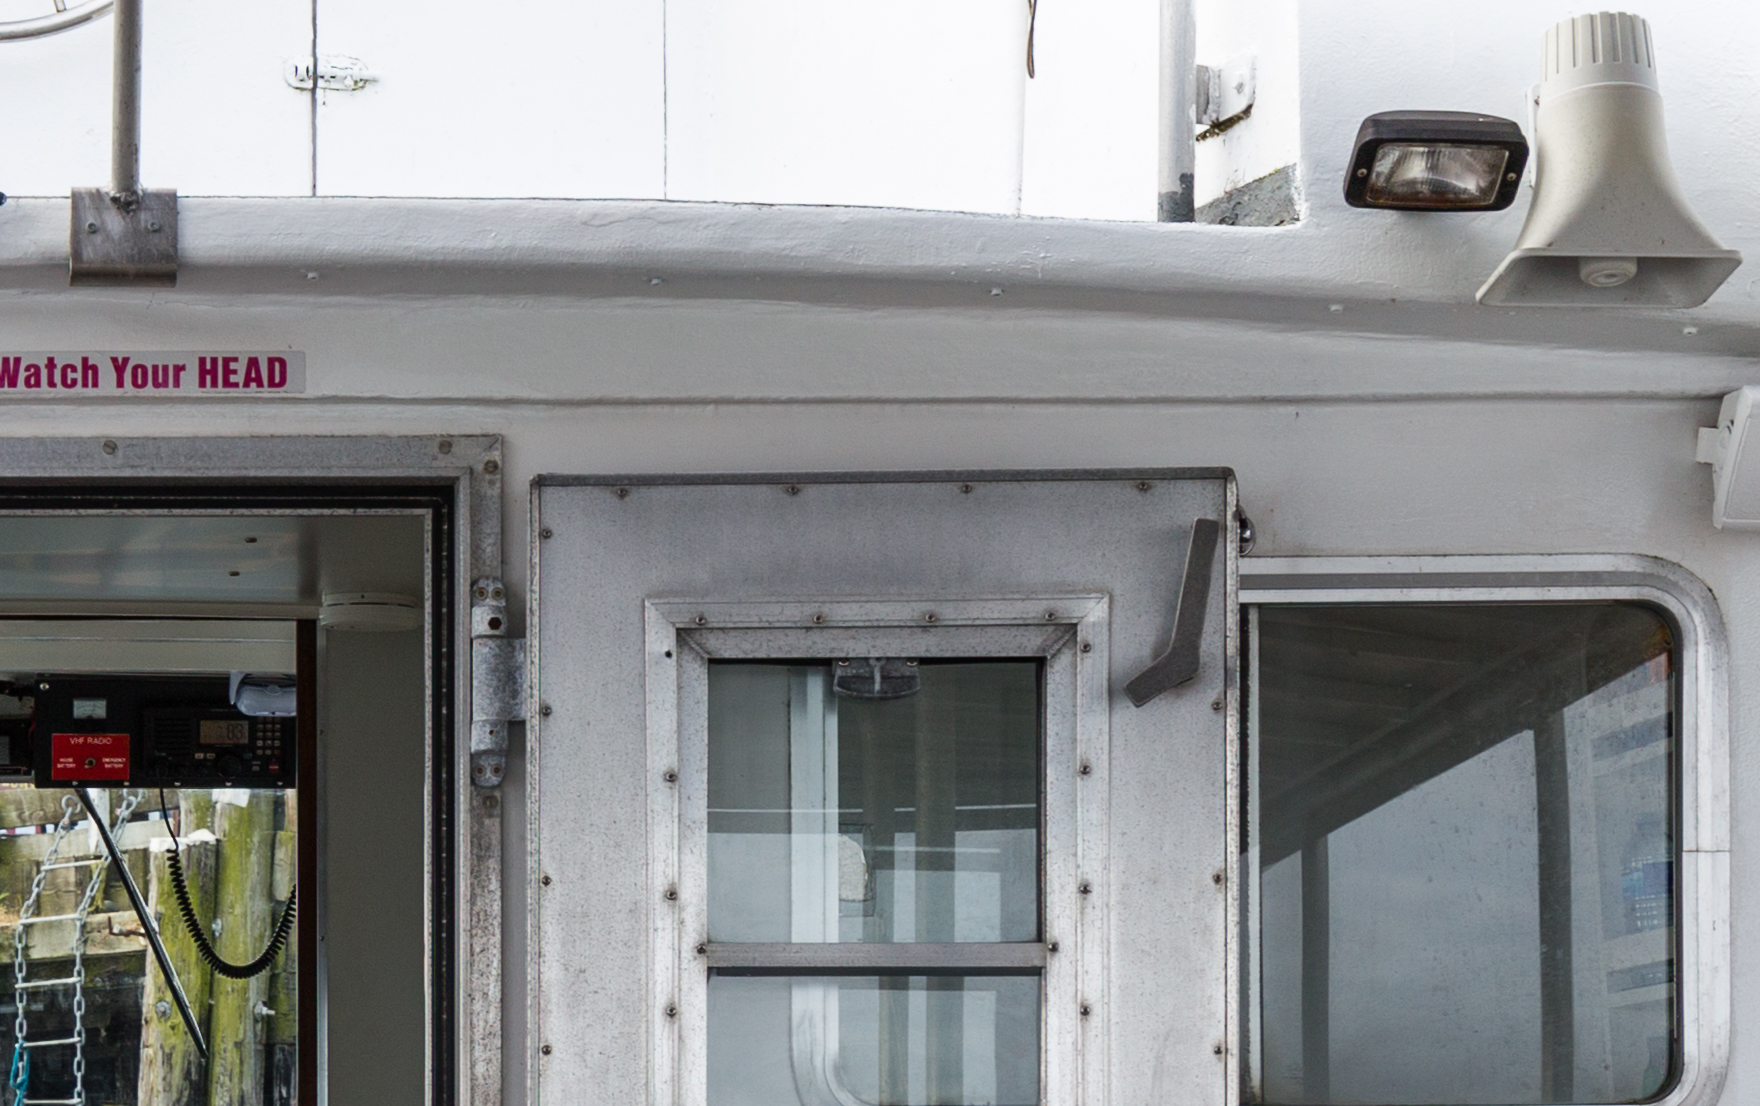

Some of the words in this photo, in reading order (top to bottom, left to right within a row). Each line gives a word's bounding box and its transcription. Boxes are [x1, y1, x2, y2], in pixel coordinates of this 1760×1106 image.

[110, 356, 186, 389] Your
[198, 356, 287, 389] HEAD
[69, 736, 84, 745] VHF
[87, 736, 112, 745] RADIO
